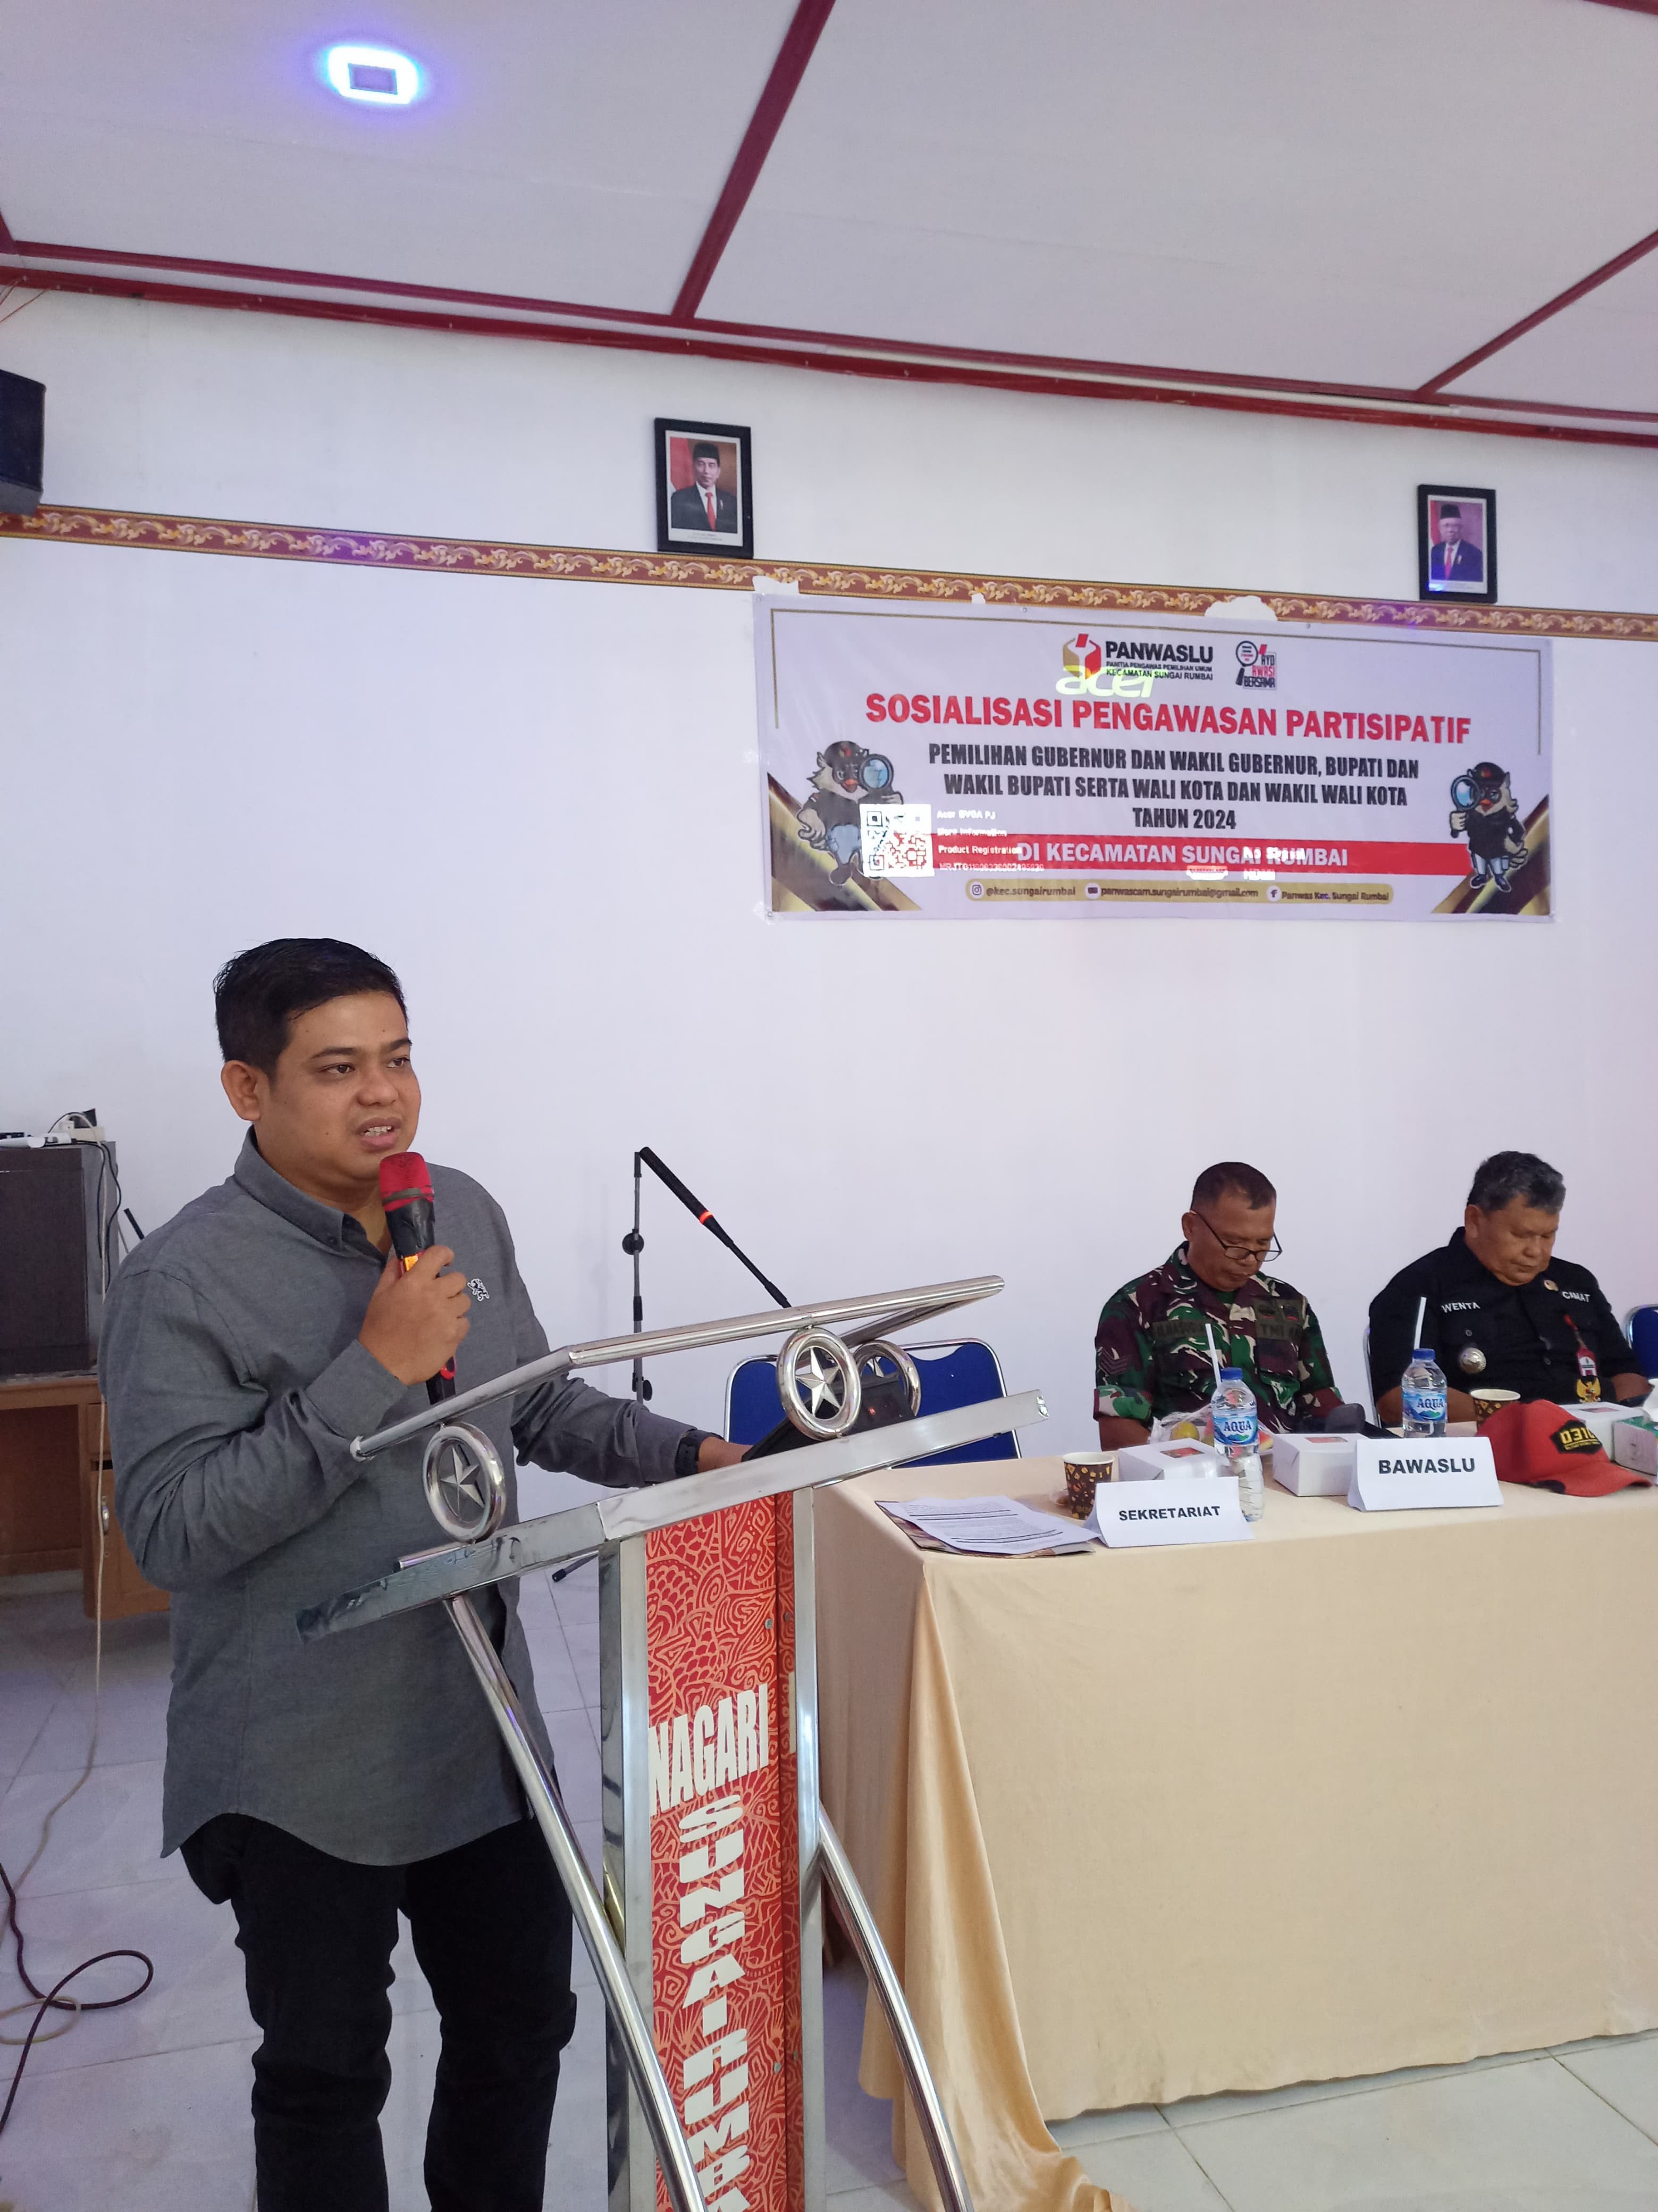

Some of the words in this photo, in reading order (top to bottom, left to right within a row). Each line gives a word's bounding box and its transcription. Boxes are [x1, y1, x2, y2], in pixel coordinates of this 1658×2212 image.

[1106, 641, 1213, 663] PANWASLU
[1056, 665, 1168, 698] acer
[1106, 669, 1152, 677] KECAMATAN
[866, 693, 1062, 727] SOSIALISASI
[1073, 700, 1276, 735] PENGAWASAN
[1286, 709, 1471, 744] PARTISIPATIF
[929, 743, 1026, 766] PEMILIHAN
[1032, 745, 1126, 769] GUBERNUR
[1131, 749, 1165, 770] DAN
[1169, 750, 1224, 772] WAKIL
[1228, 753, 1322, 777] GUBERNUR,
[1326, 756, 1382, 777] BUPATI
[1387, 758, 1419, 779] DAN
[944, 774, 1003, 795] WAKIL
[1008, 775, 1071, 796] BUPATI
[1075, 777, 1129, 798] SERTA
[1132, 778, 1175, 800] WALI
[1181, 780, 1224, 800] KOTA
[1227, 782, 1260, 802] DAN
[1265, 783, 1318, 803] WAKIL
[1322, 784, 1362, 805] WALI
[1367, 786, 1408, 806] KOTA
[1132, 808, 1188, 828] TAHUN
[1193, 809, 1236, 829] 2024
[938, 845, 970, 854] Product
[1017, 842, 1040, 861] DI
[1047, 843, 1175, 862] KECAMATAN
[1182, 845, 1260, 865] SUNGAI
[1266, 847, 1348, 866] RUMBAI
[986, 886, 1076, 898] @kec.sungairumbai
[1332, 892, 1358, 902] Sungai
[1441, 1302, 1480, 1313] WENTA
[1417, 1398, 1444, 1410] AQUA
[1224, 1420, 1252, 1433] AQUA
[1378, 1458, 1475, 1474] BAWASLU
[1119, 1506, 1220, 1521] SEKRETARIAT
[649, 1683, 769, 1817] NAGARI
[679, 1795, 745, 2038] SUNGAI
